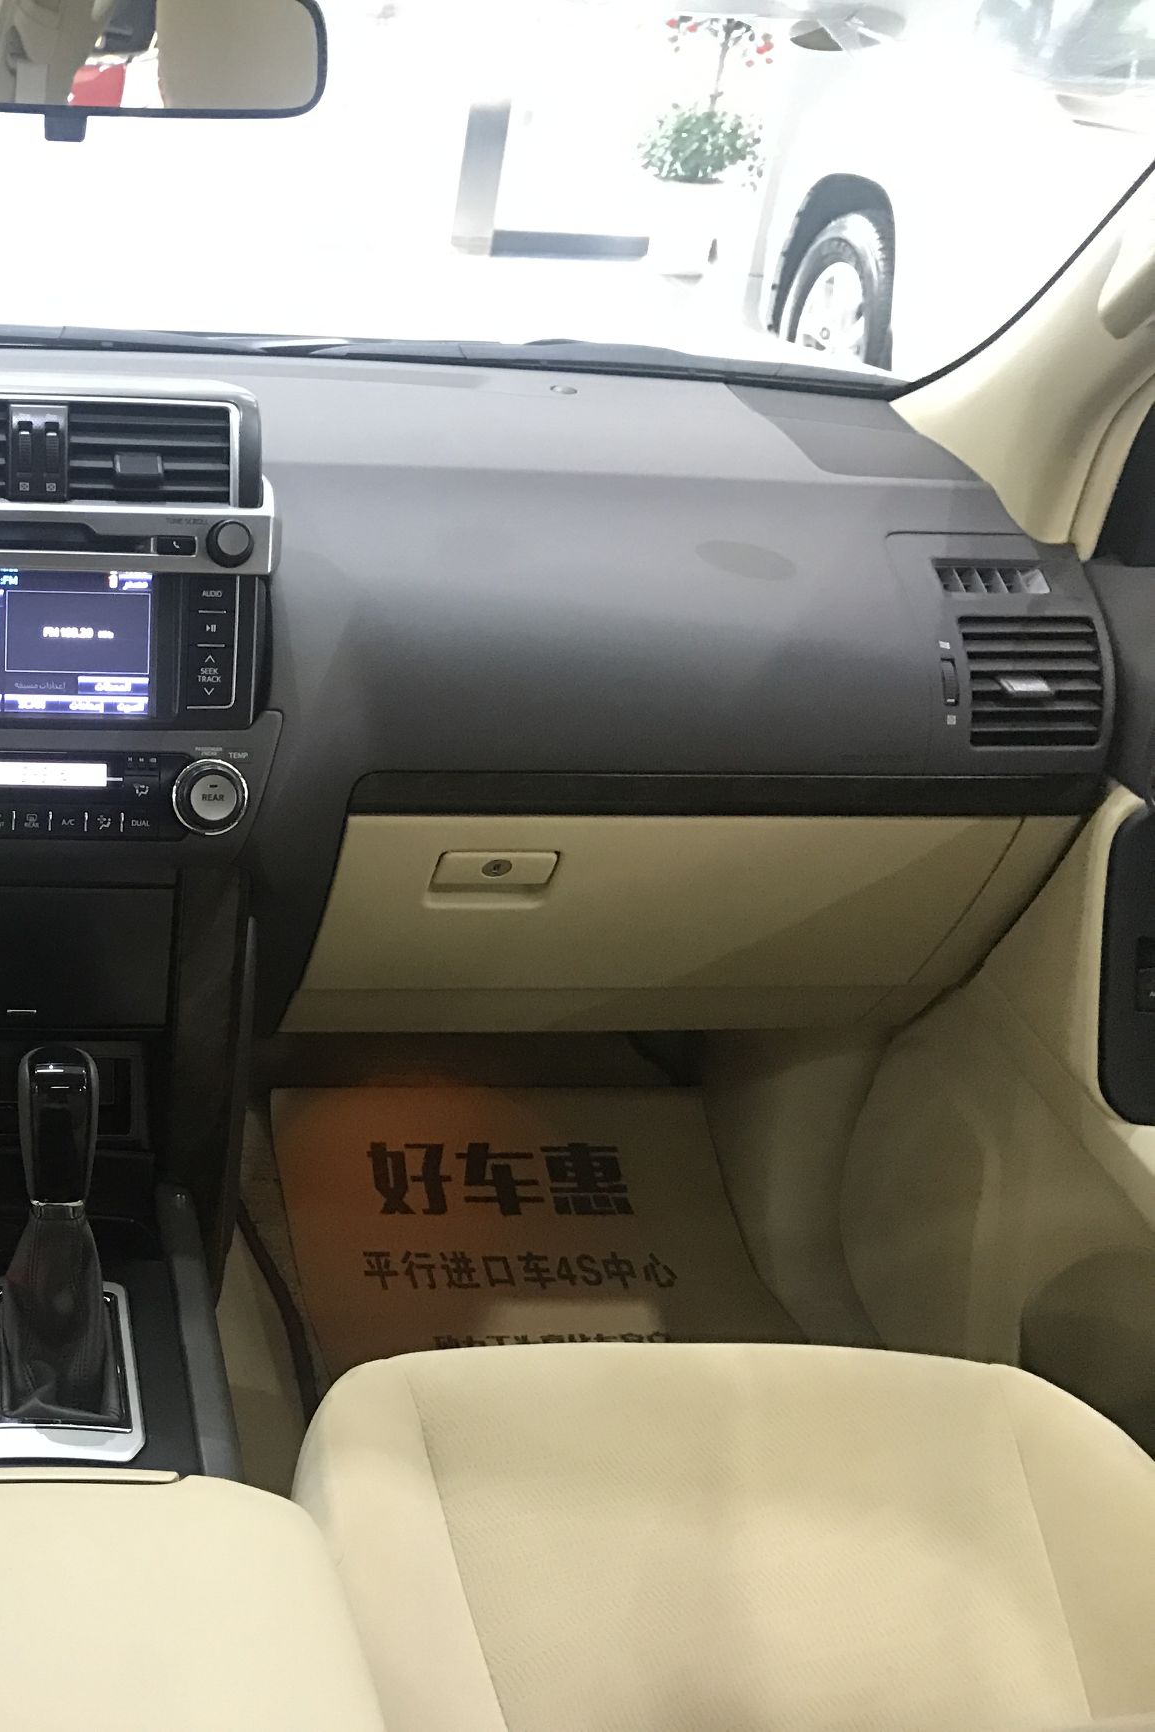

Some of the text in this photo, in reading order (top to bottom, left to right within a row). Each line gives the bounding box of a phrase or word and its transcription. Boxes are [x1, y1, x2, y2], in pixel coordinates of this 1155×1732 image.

[202, 590, 223, 598] AUDIO
[200, 667, 219, 675] SEEK
[198, 675, 222, 683] TRACK
[201, 793, 225, 802] REAR
[61, 817, 76, 826] A/C
[131, 819, 150, 827] DUAL
[366, 1142, 635, 1216] 好车惠
[362, 1251, 678, 1290] 平行进口车4S中心
